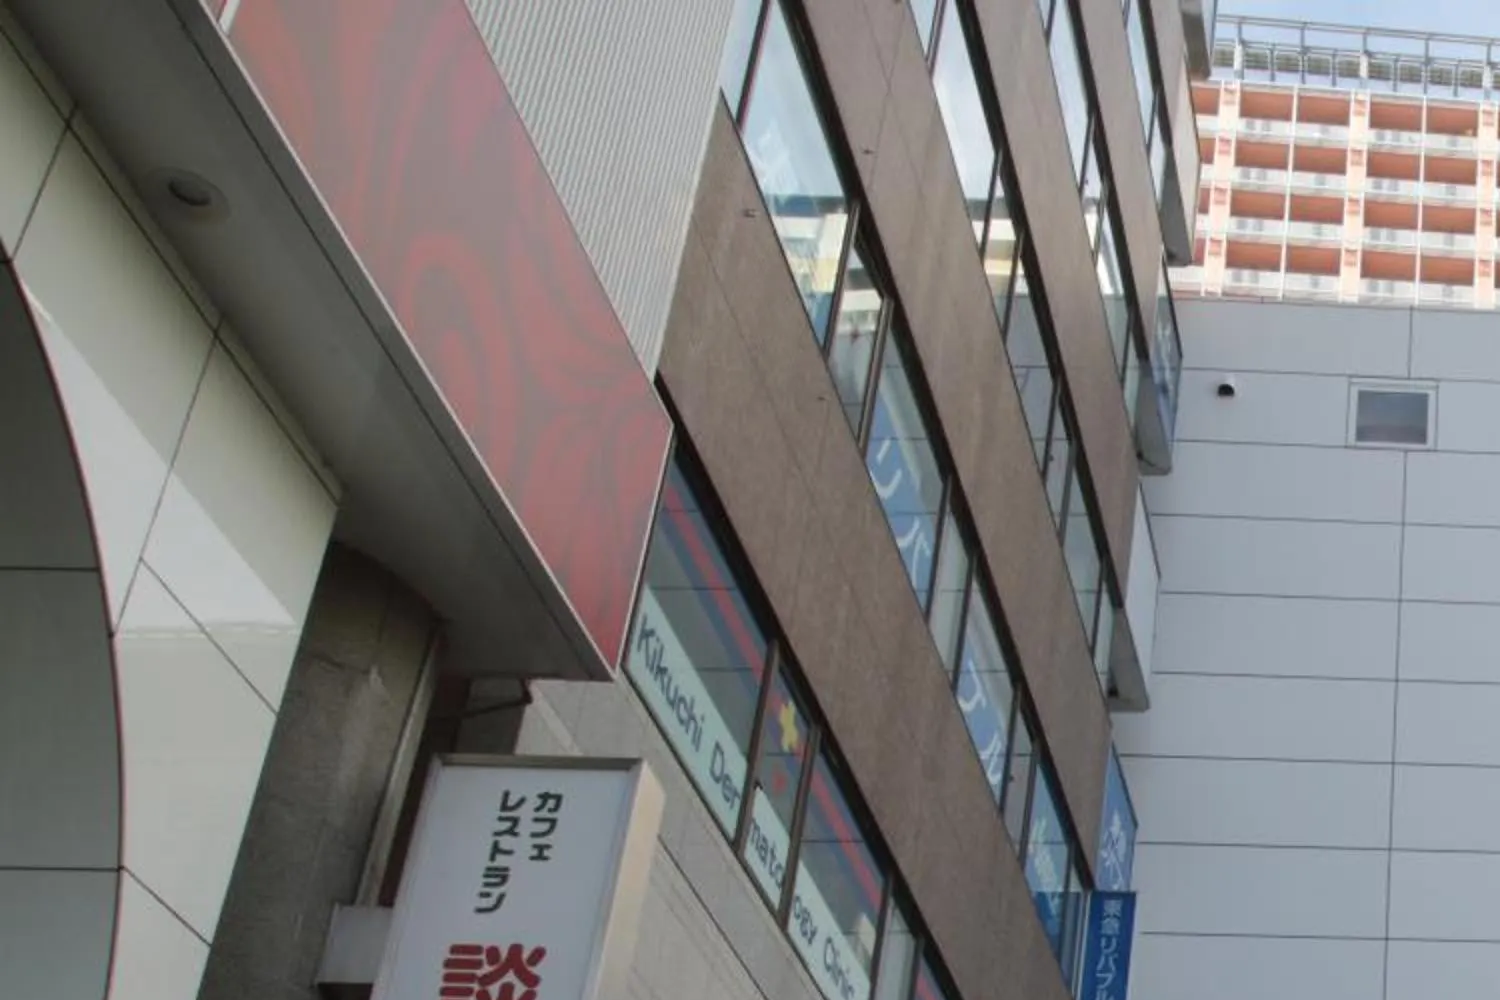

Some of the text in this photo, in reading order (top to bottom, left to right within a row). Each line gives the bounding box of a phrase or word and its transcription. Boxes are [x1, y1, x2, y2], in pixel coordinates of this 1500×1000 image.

[637, 614, 705, 752] Kikuchi
[474, 790, 526, 914] レストラン
[529, 791, 563, 861] カフェ
